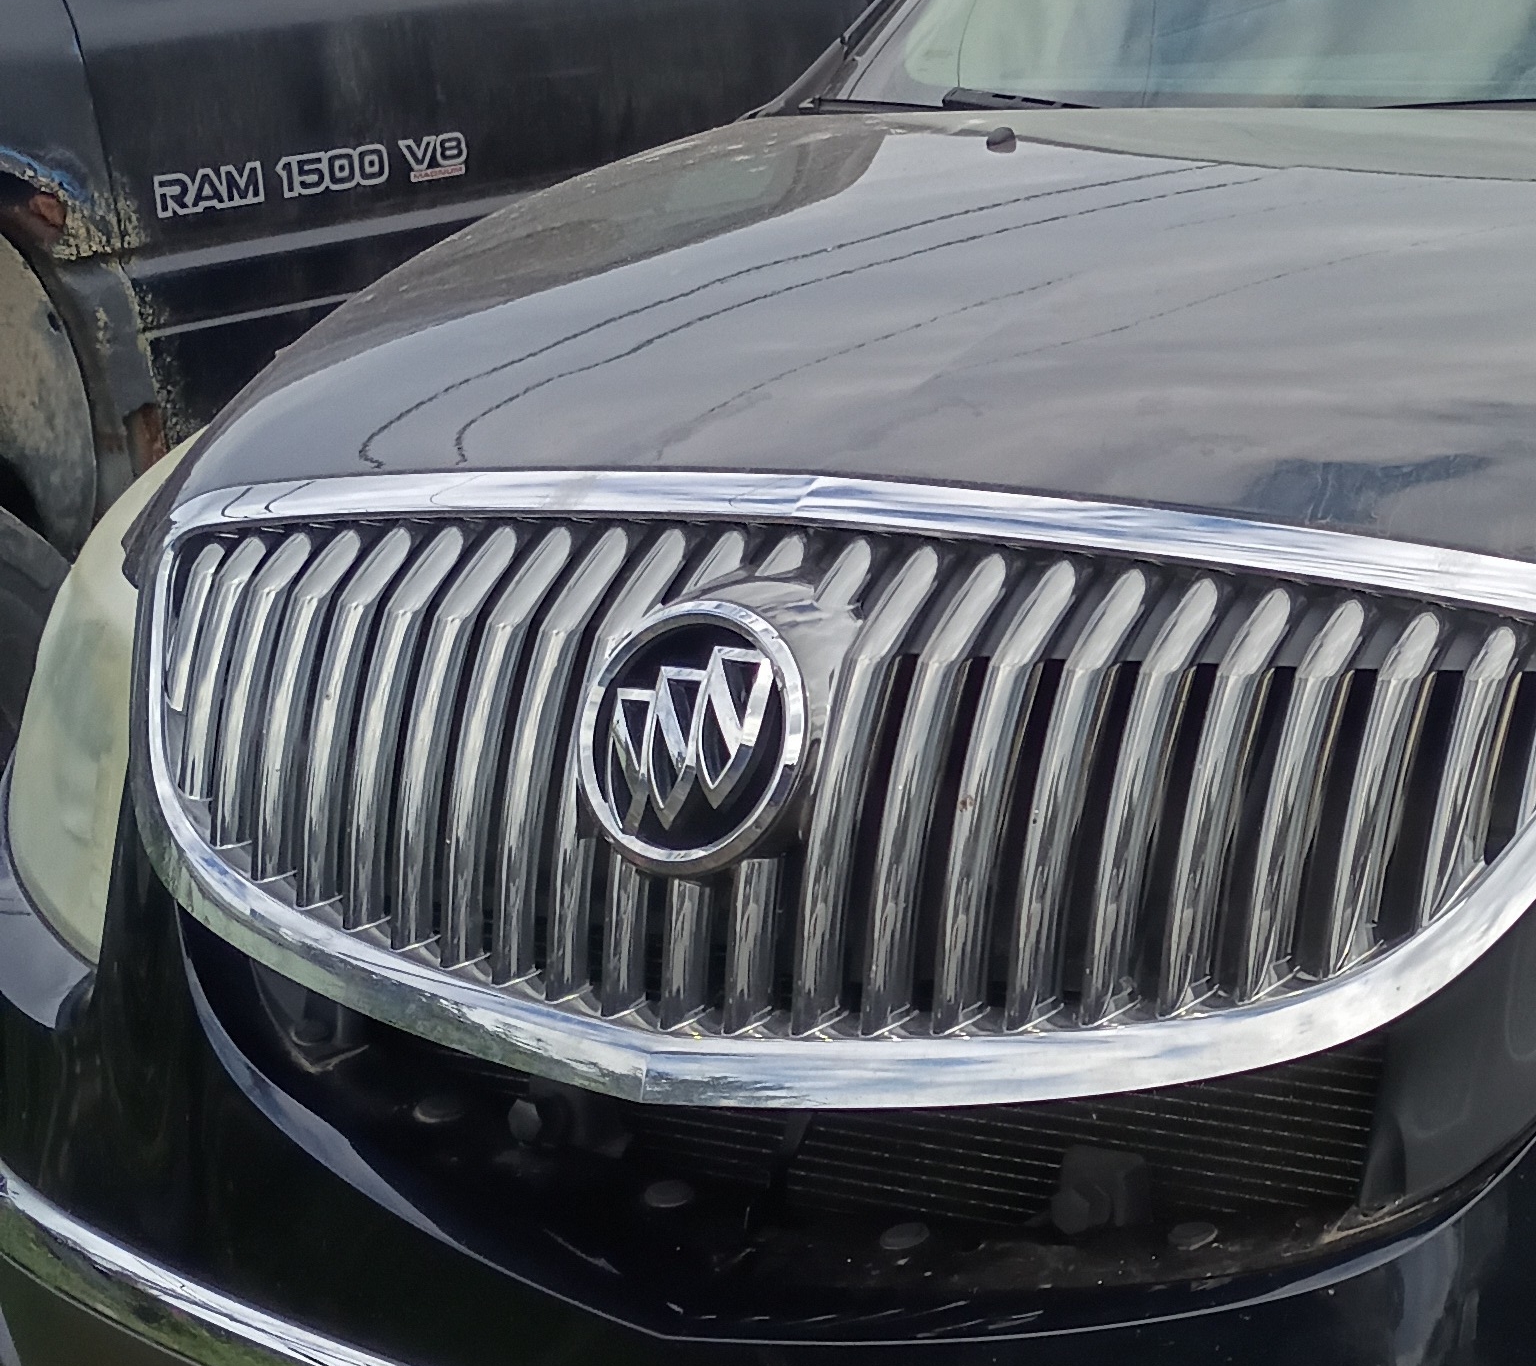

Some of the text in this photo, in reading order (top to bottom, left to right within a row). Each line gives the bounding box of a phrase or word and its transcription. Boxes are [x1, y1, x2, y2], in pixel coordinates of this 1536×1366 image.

[152, 131, 468, 219] RAM 1500 V8
